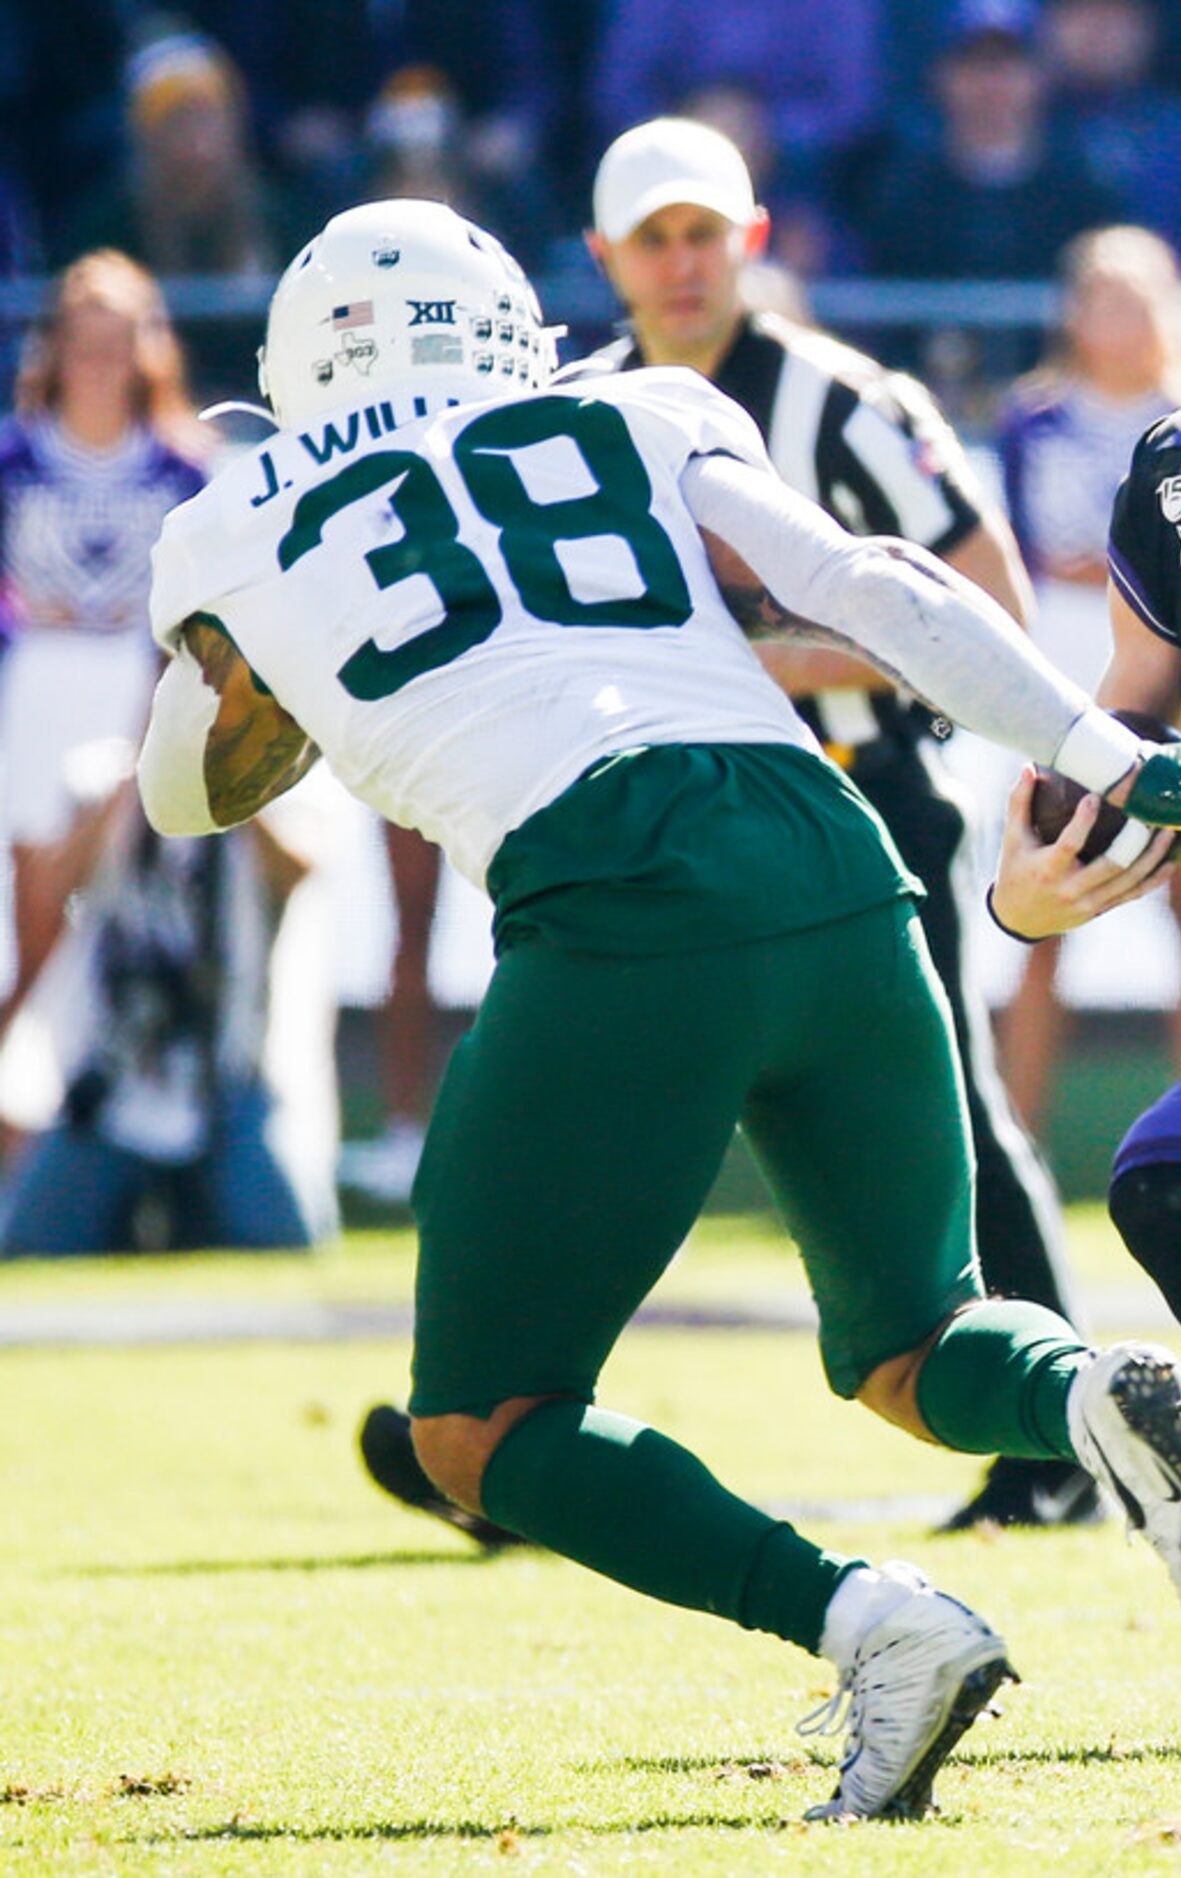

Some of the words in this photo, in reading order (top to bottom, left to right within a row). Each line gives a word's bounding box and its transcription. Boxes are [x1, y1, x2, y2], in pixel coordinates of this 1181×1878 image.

[405, 300, 457, 326] XII
[251, 451, 294, 508] J.
[277, 395, 694, 702] 38
